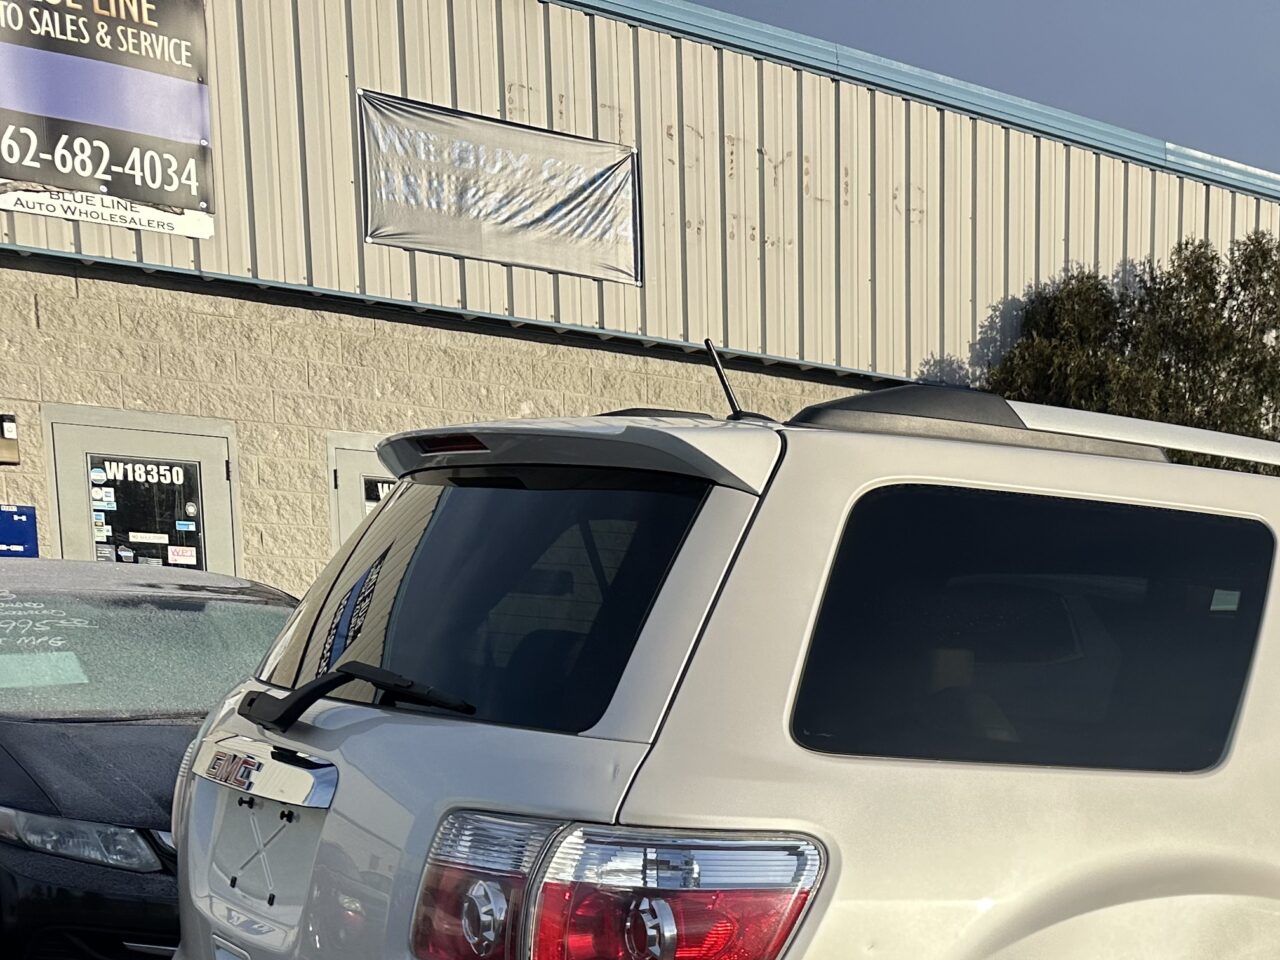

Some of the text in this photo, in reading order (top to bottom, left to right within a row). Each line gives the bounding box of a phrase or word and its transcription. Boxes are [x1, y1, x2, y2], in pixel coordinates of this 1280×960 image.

[29, 8, 90, 44] SALES
[95, 22, 112, 50] &
[116, 26, 192, 67] SERVICE
[0, 124, 199, 196] 62-682-4034
[13, 197, 175, 231] AUTO WHOLESALERS
[49, 191, 140, 213] BLUE LINE
[104, 461, 184, 485] W18350
[206, 751, 264, 791] GMC
